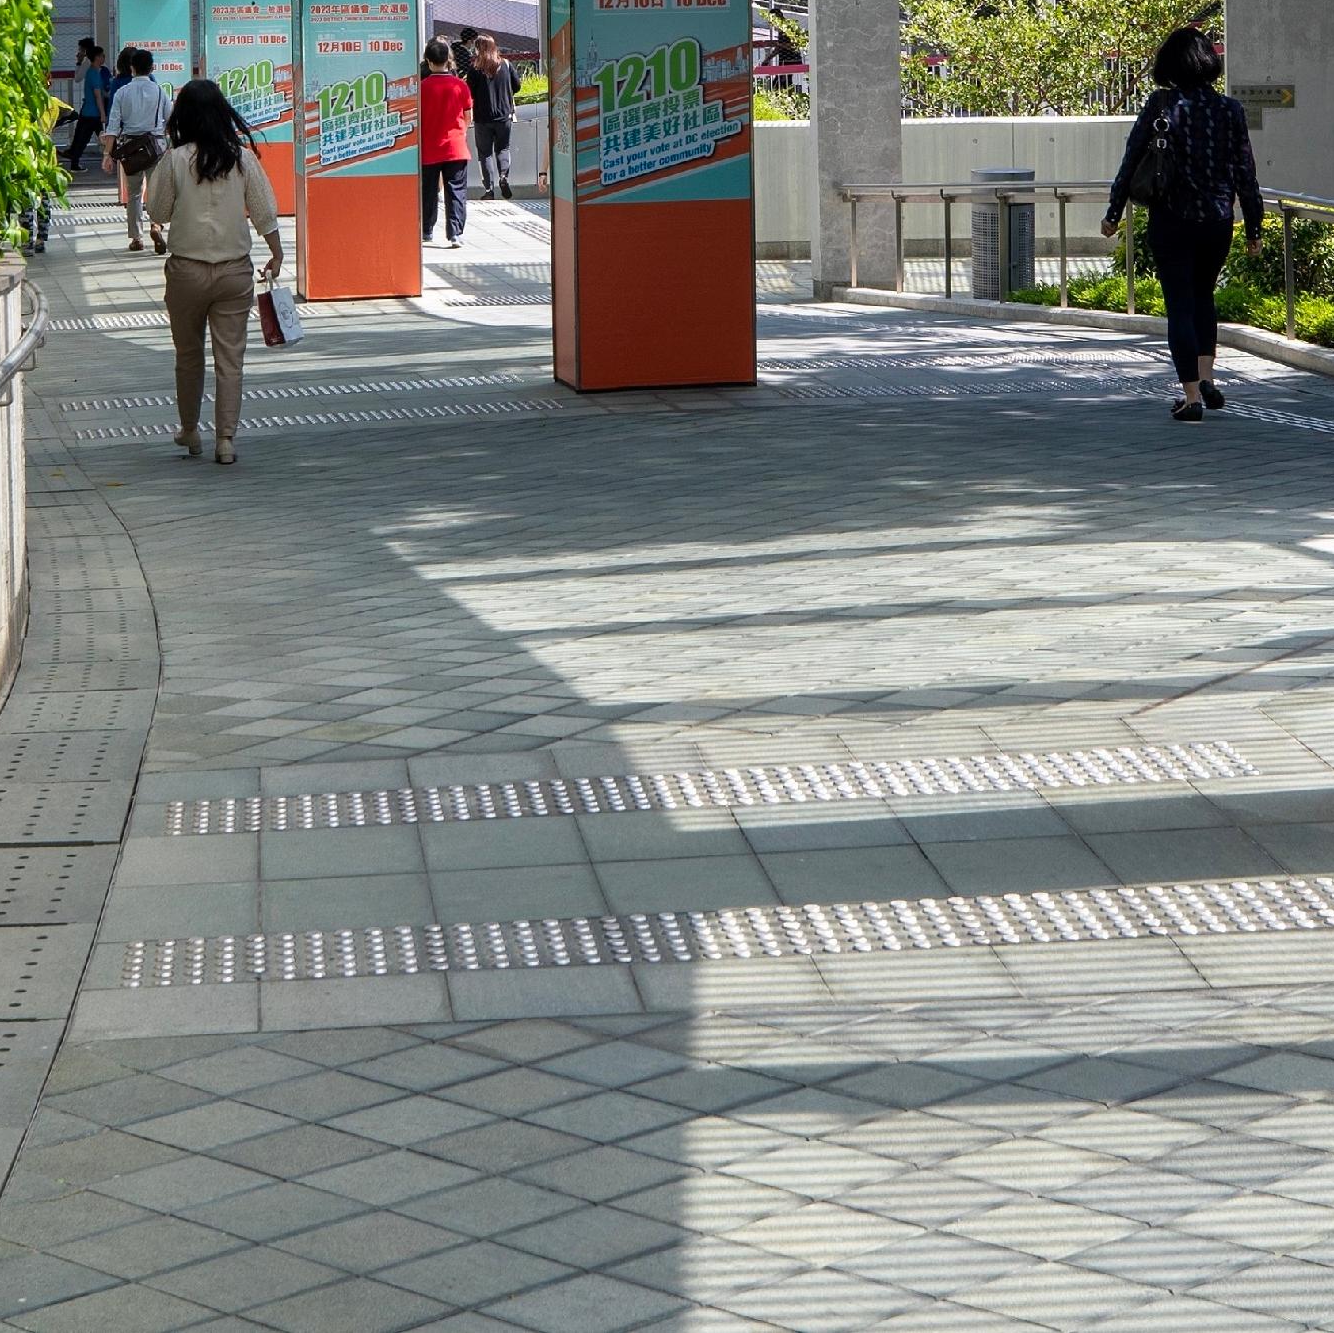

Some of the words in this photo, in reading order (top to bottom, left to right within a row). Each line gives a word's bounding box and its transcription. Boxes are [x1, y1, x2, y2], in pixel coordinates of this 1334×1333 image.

[218, 35, 254, 45] 12月10日
[259, 35, 269, 44] 10
[317, 41, 361, 53] 12月10日
[369, 40, 380, 52] 10
[382, 40, 403, 52] Dec
[170, 63, 183, 71] Dec
[217, 61, 273, 97] 1210
[593, 40, 699, 113] 1210
[315, 73, 385, 119] 1210
[603, 92, 700, 136] 區選齊投票
[603, 104, 720, 156] 共建美好社區
[603, 156, 624, 170] Cast
[627, 150, 647, 165] your
[650, 142, 670, 155] vote
[673, 139, 682, 148] at
[685, 133, 698, 145] DC
[700, 122, 739, 140] election
[603, 170, 618, 183] for
[619, 168, 626, 177] a
[628, 159, 656, 174] better
[659, 142, 712, 165] community
